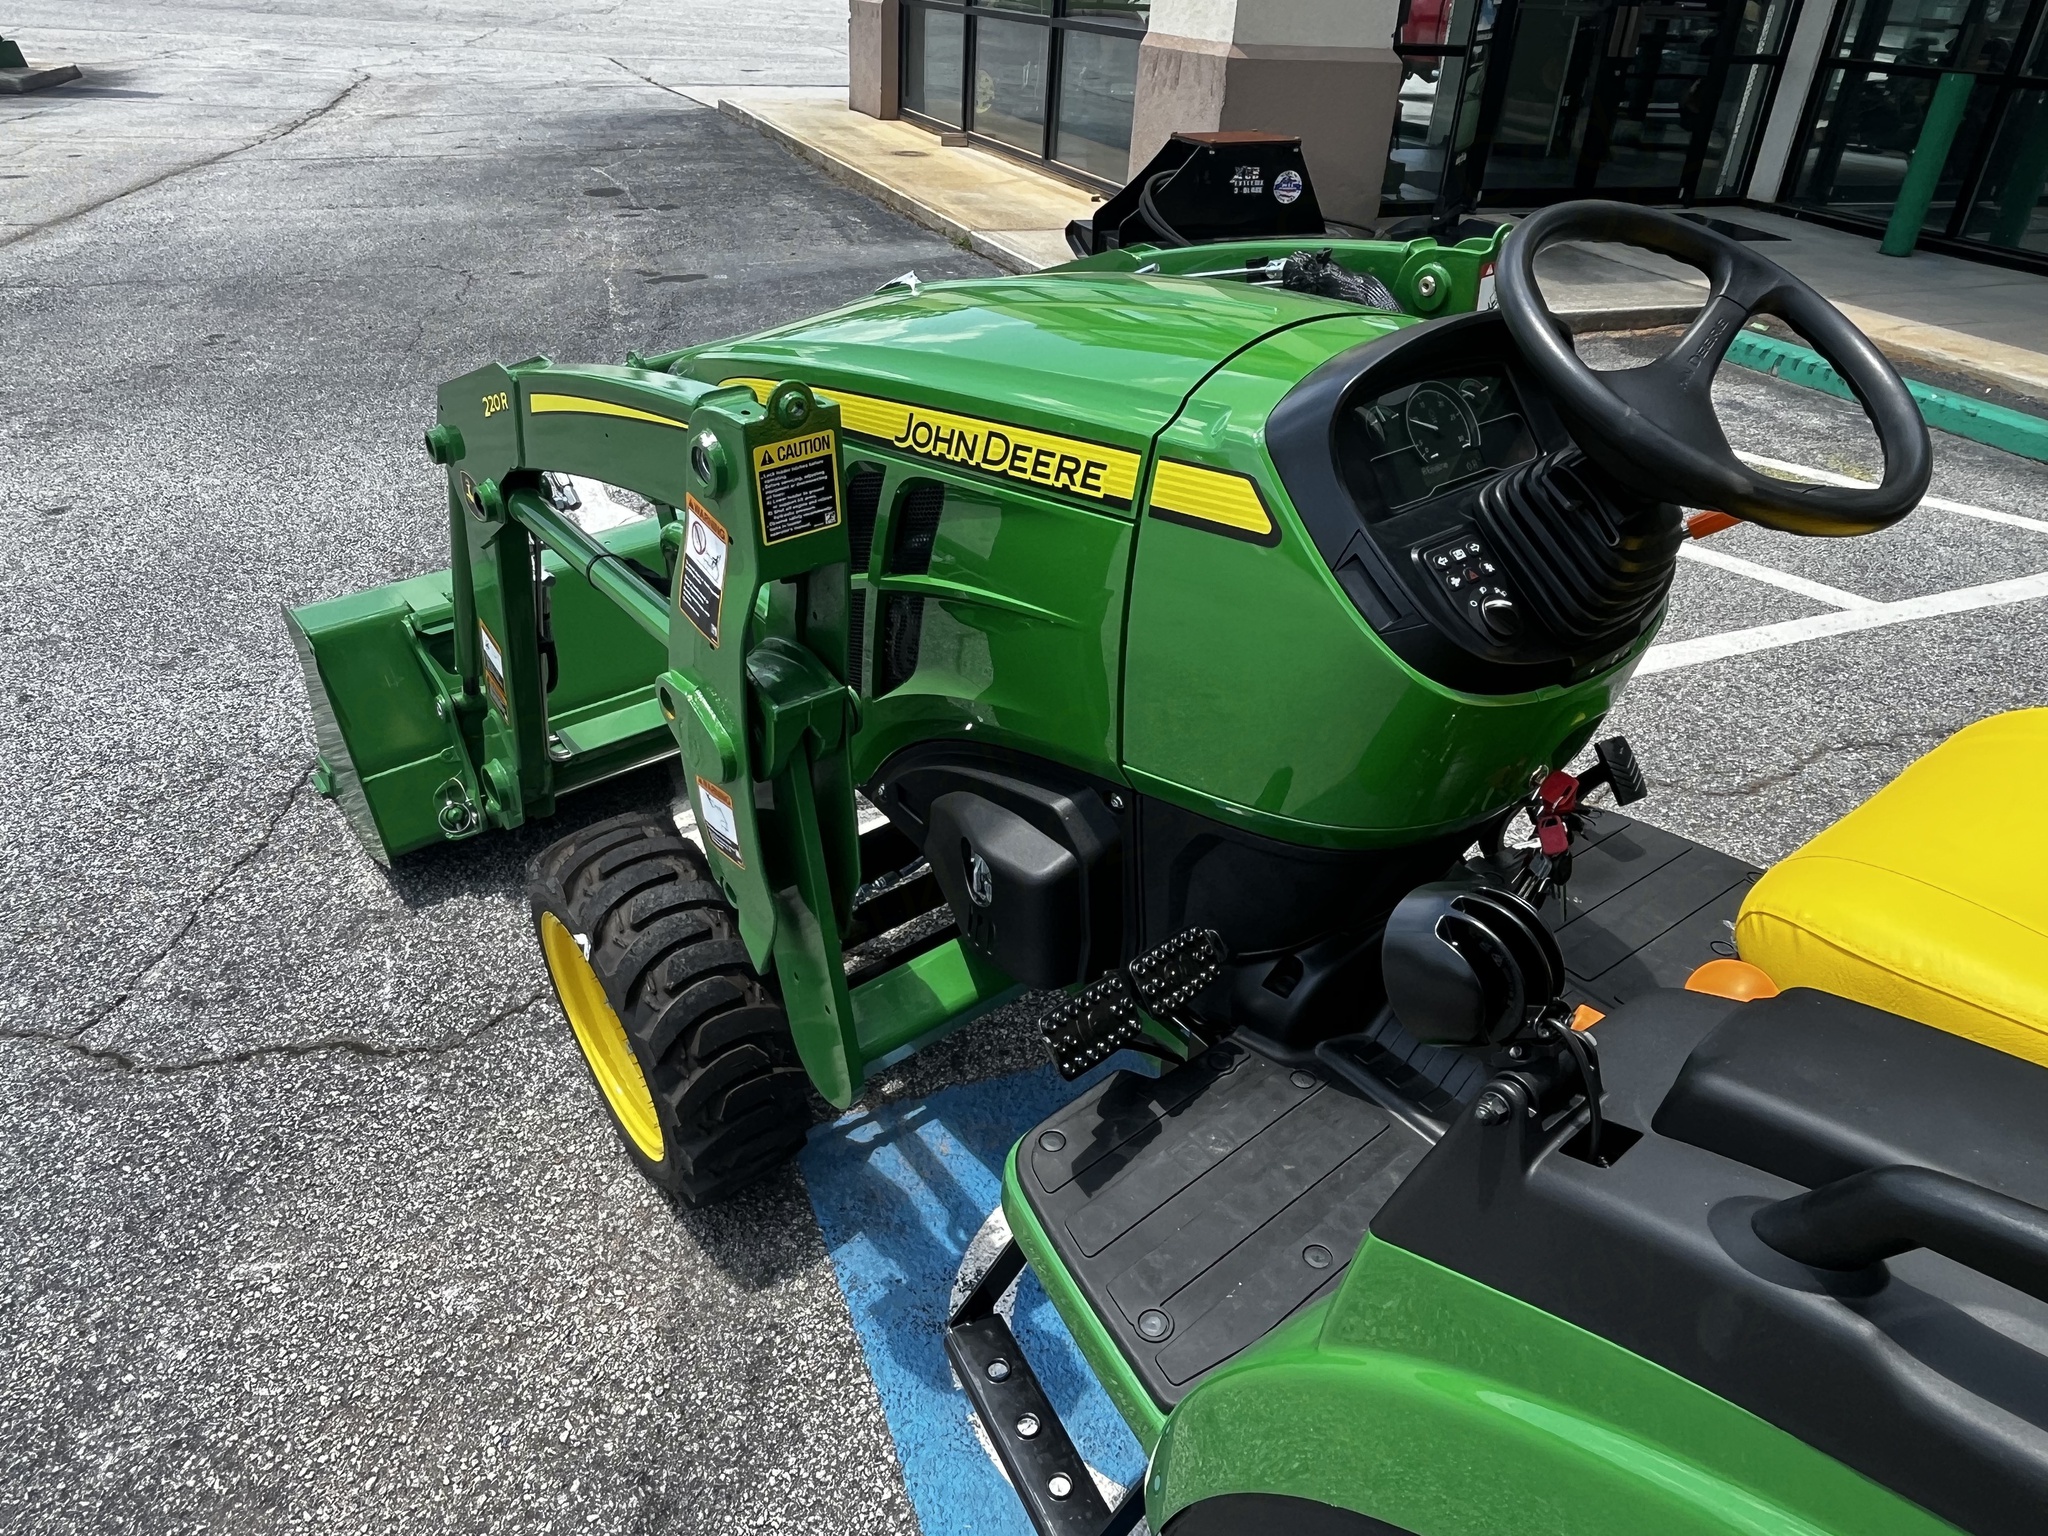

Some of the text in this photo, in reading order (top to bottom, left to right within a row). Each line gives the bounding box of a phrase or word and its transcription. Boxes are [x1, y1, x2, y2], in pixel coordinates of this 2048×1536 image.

[481, 391, 509, 418] 220R
[776, 434, 831, 462] CAUTION
[894, 412, 1108, 493] JOHN DEERE
